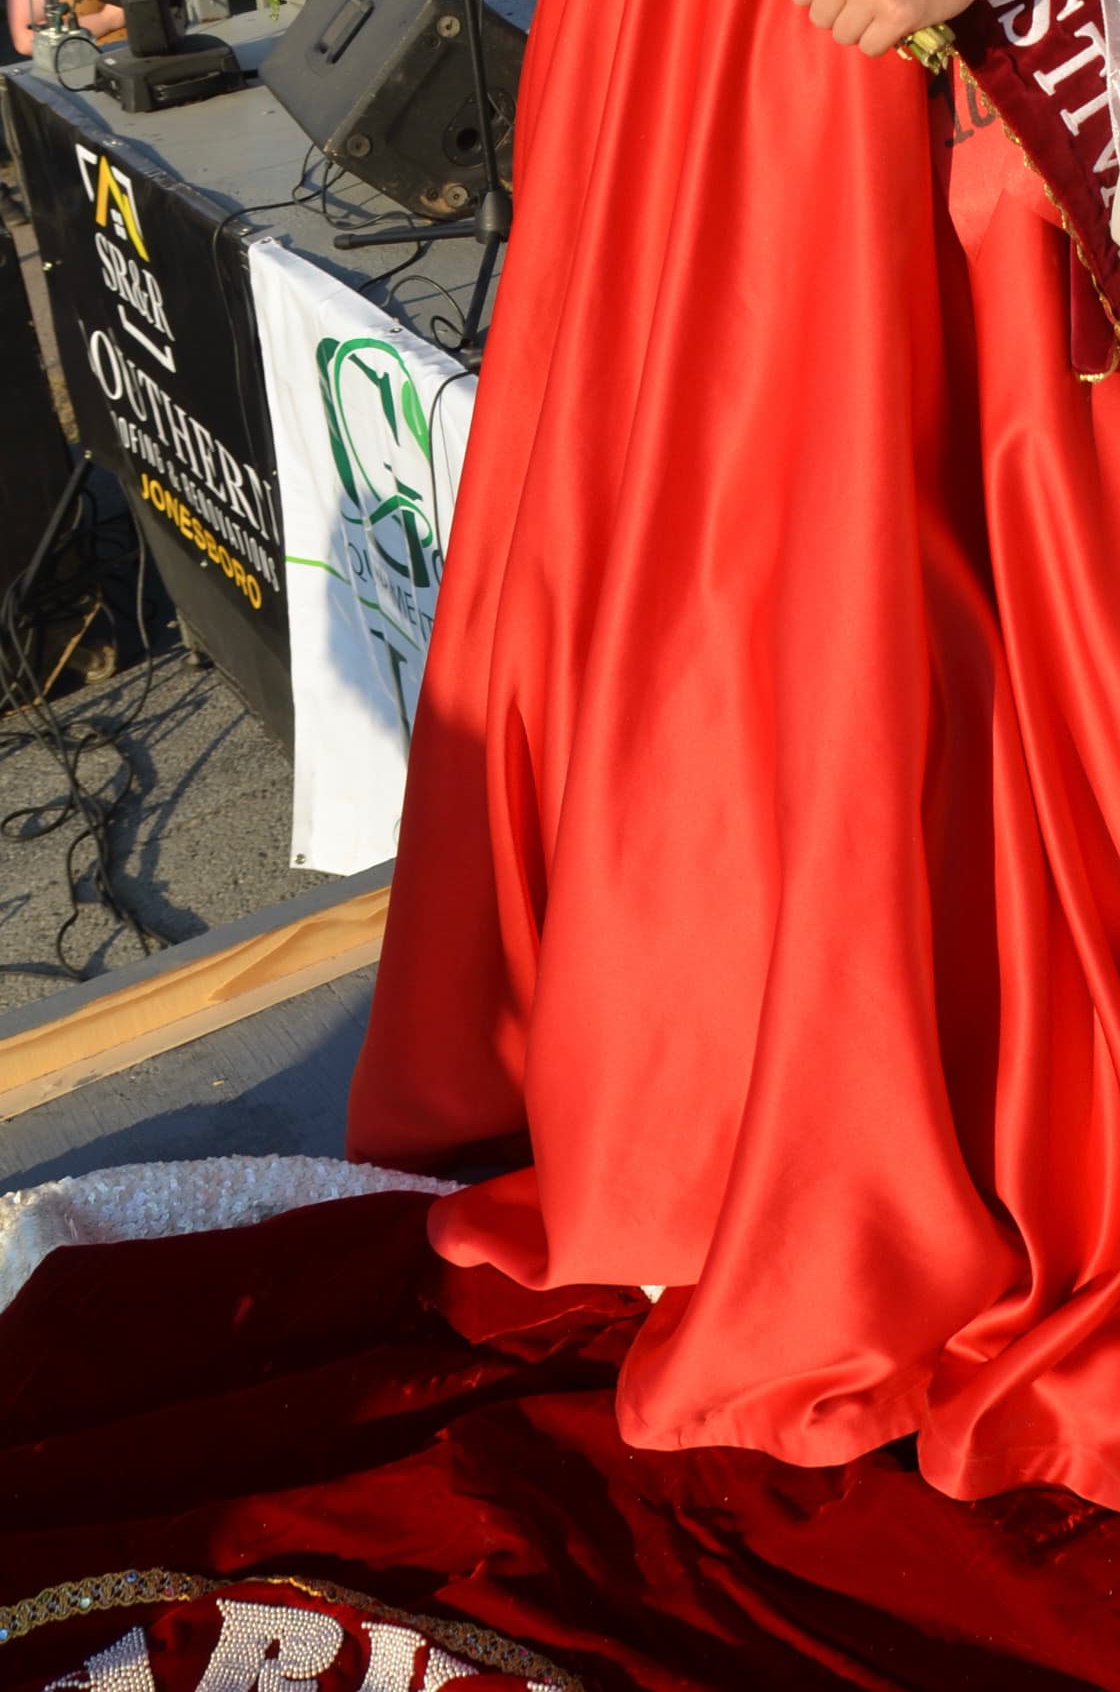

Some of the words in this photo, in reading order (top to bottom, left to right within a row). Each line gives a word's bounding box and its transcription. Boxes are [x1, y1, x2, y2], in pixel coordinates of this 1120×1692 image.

[95, 232, 176, 341] SR&R
[80, 319, 280, 545] OUTHERN
[141, 472, 262, 610] JONESBORO
